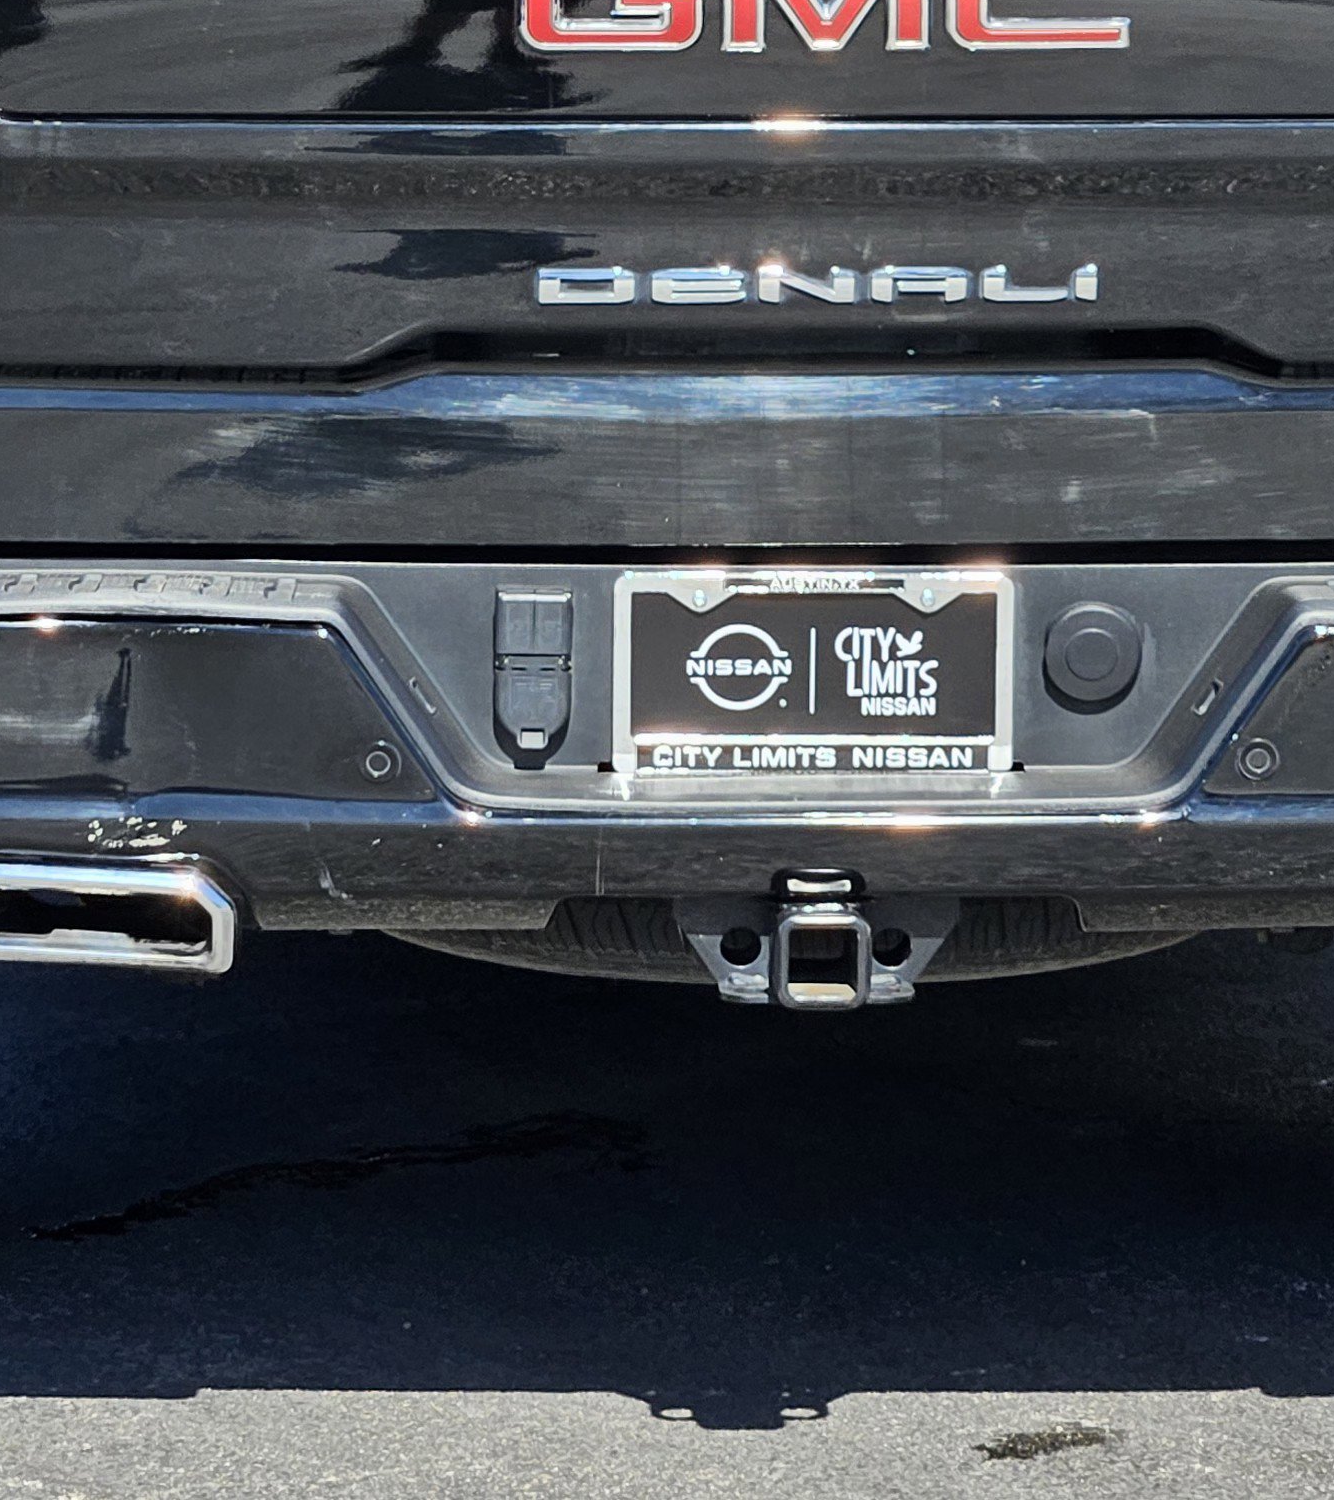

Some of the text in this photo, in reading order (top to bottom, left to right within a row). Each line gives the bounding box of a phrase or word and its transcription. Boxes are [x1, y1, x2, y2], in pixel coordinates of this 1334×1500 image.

[537, 266, 1100, 305] DENALI
[834, 627, 896, 663] CITY
[686, 659, 792, 676] NISSAN
[847, 660, 939, 698] LIMITS
[861, 697, 936, 716] NISSAN
[653, 746, 972, 768] CITY LIMITS NISSAN
